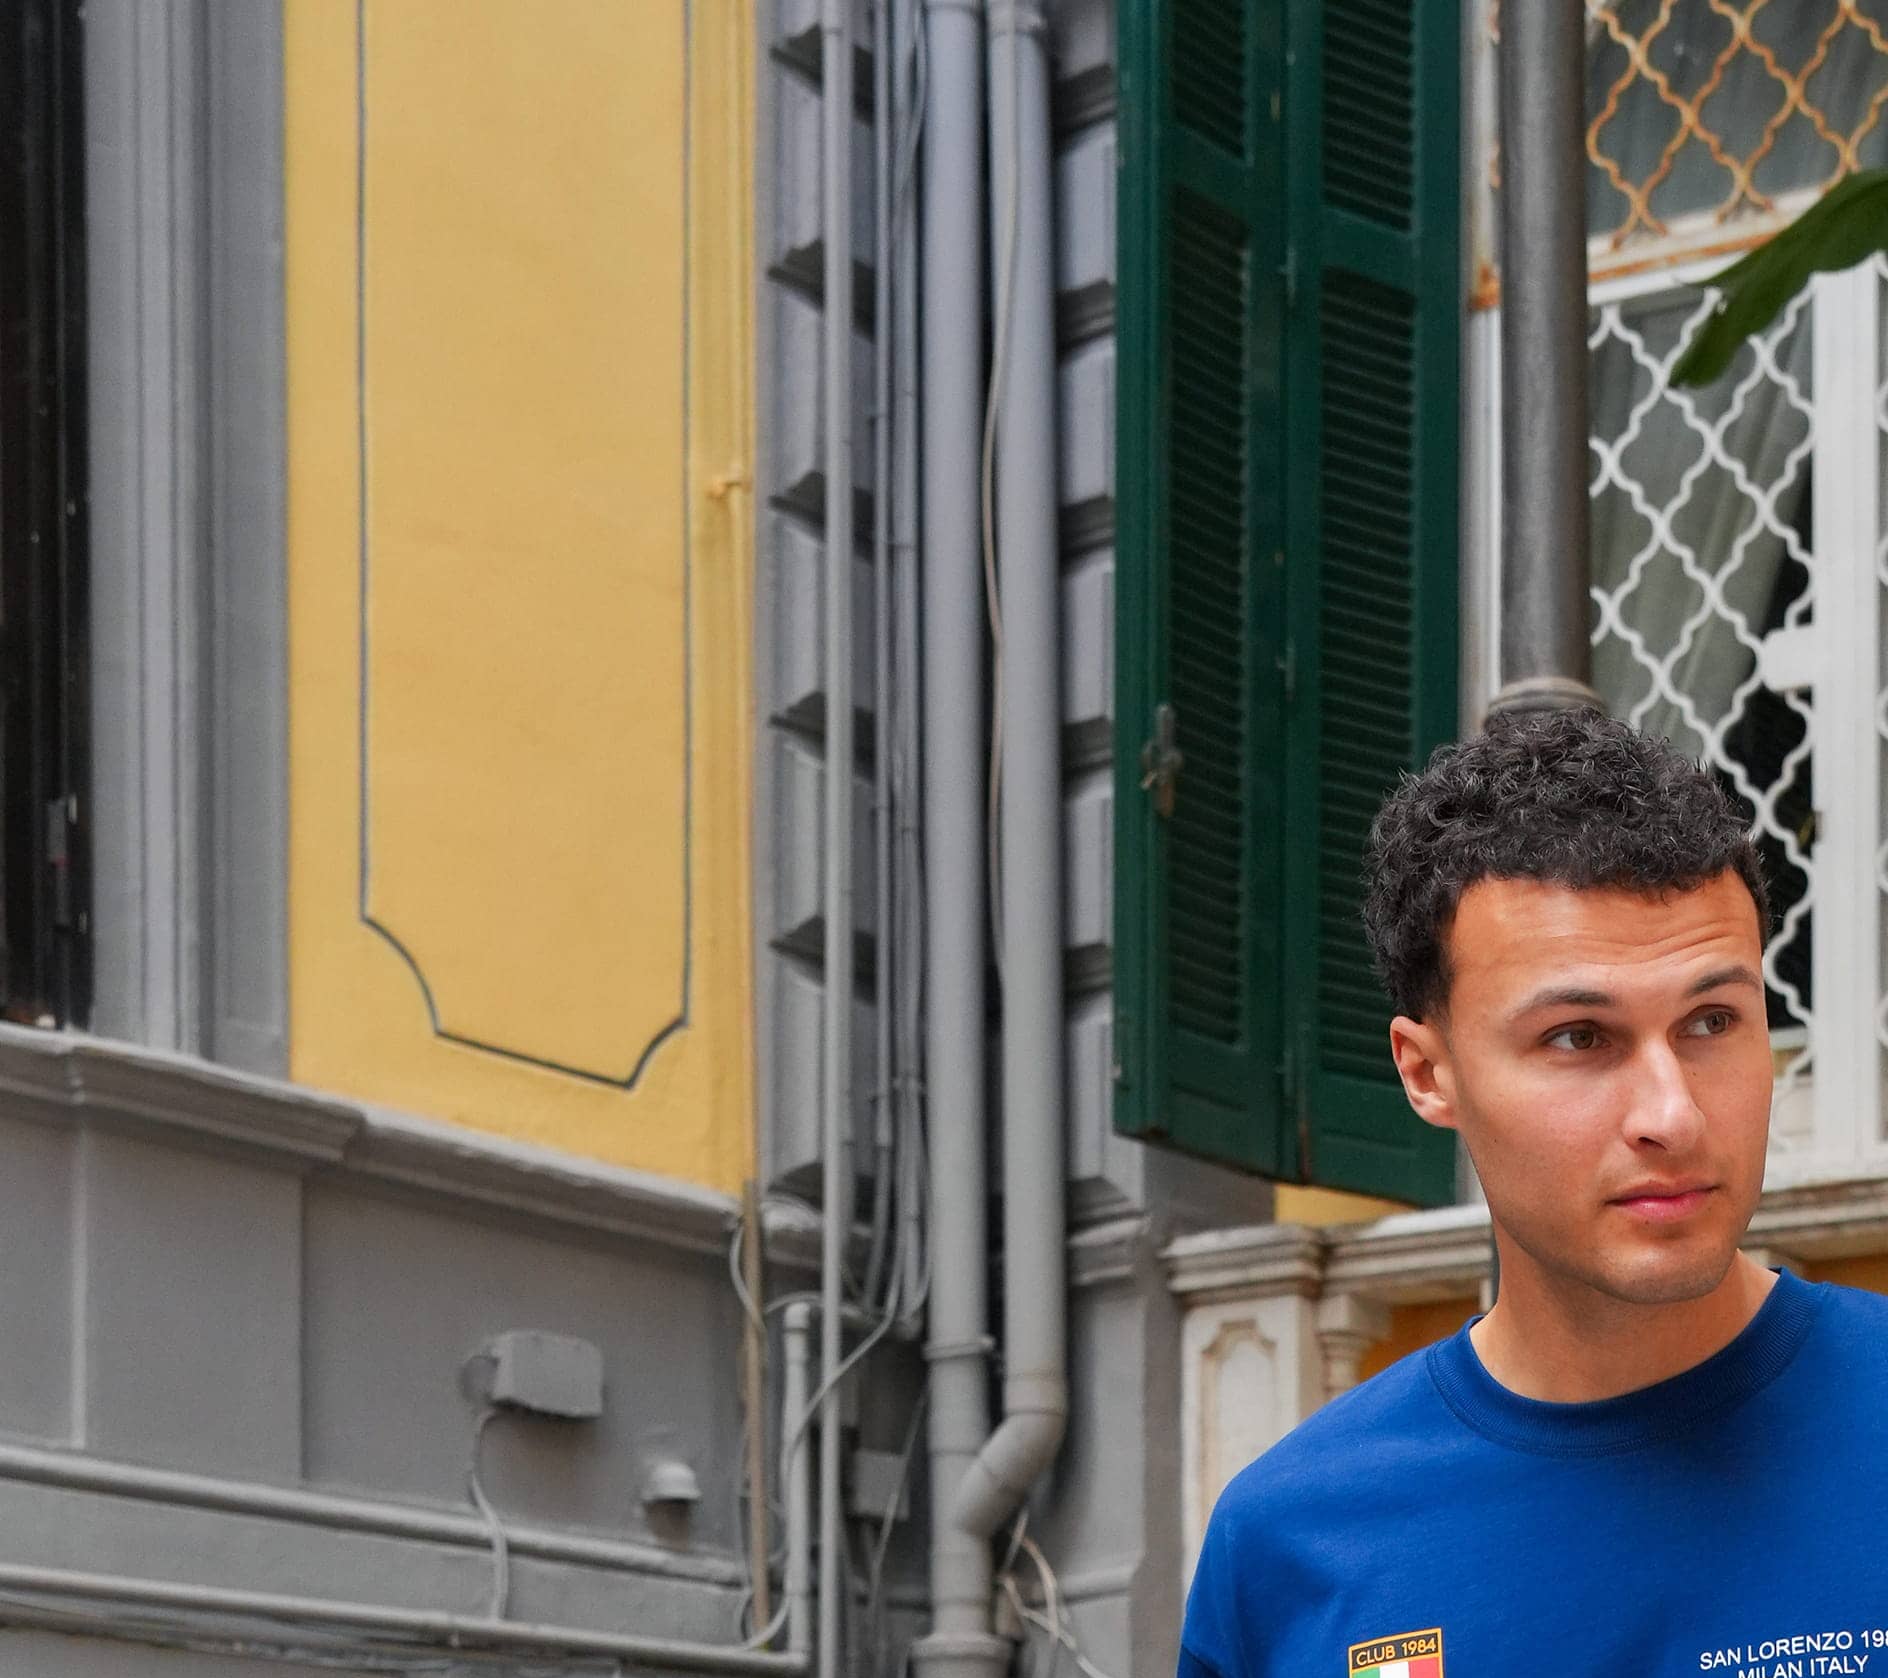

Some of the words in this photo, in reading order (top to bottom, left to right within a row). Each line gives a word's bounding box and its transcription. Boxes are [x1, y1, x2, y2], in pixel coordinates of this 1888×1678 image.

[1356, 1645, 1395, 1666] CLUB
[1401, 1637, 1437, 1656] 1984
[1699, 1647, 1742, 1670] SAN
[1747, 1631, 1853, 1662] LORENZO
[1810, 1655, 1869, 1677] ITALY
